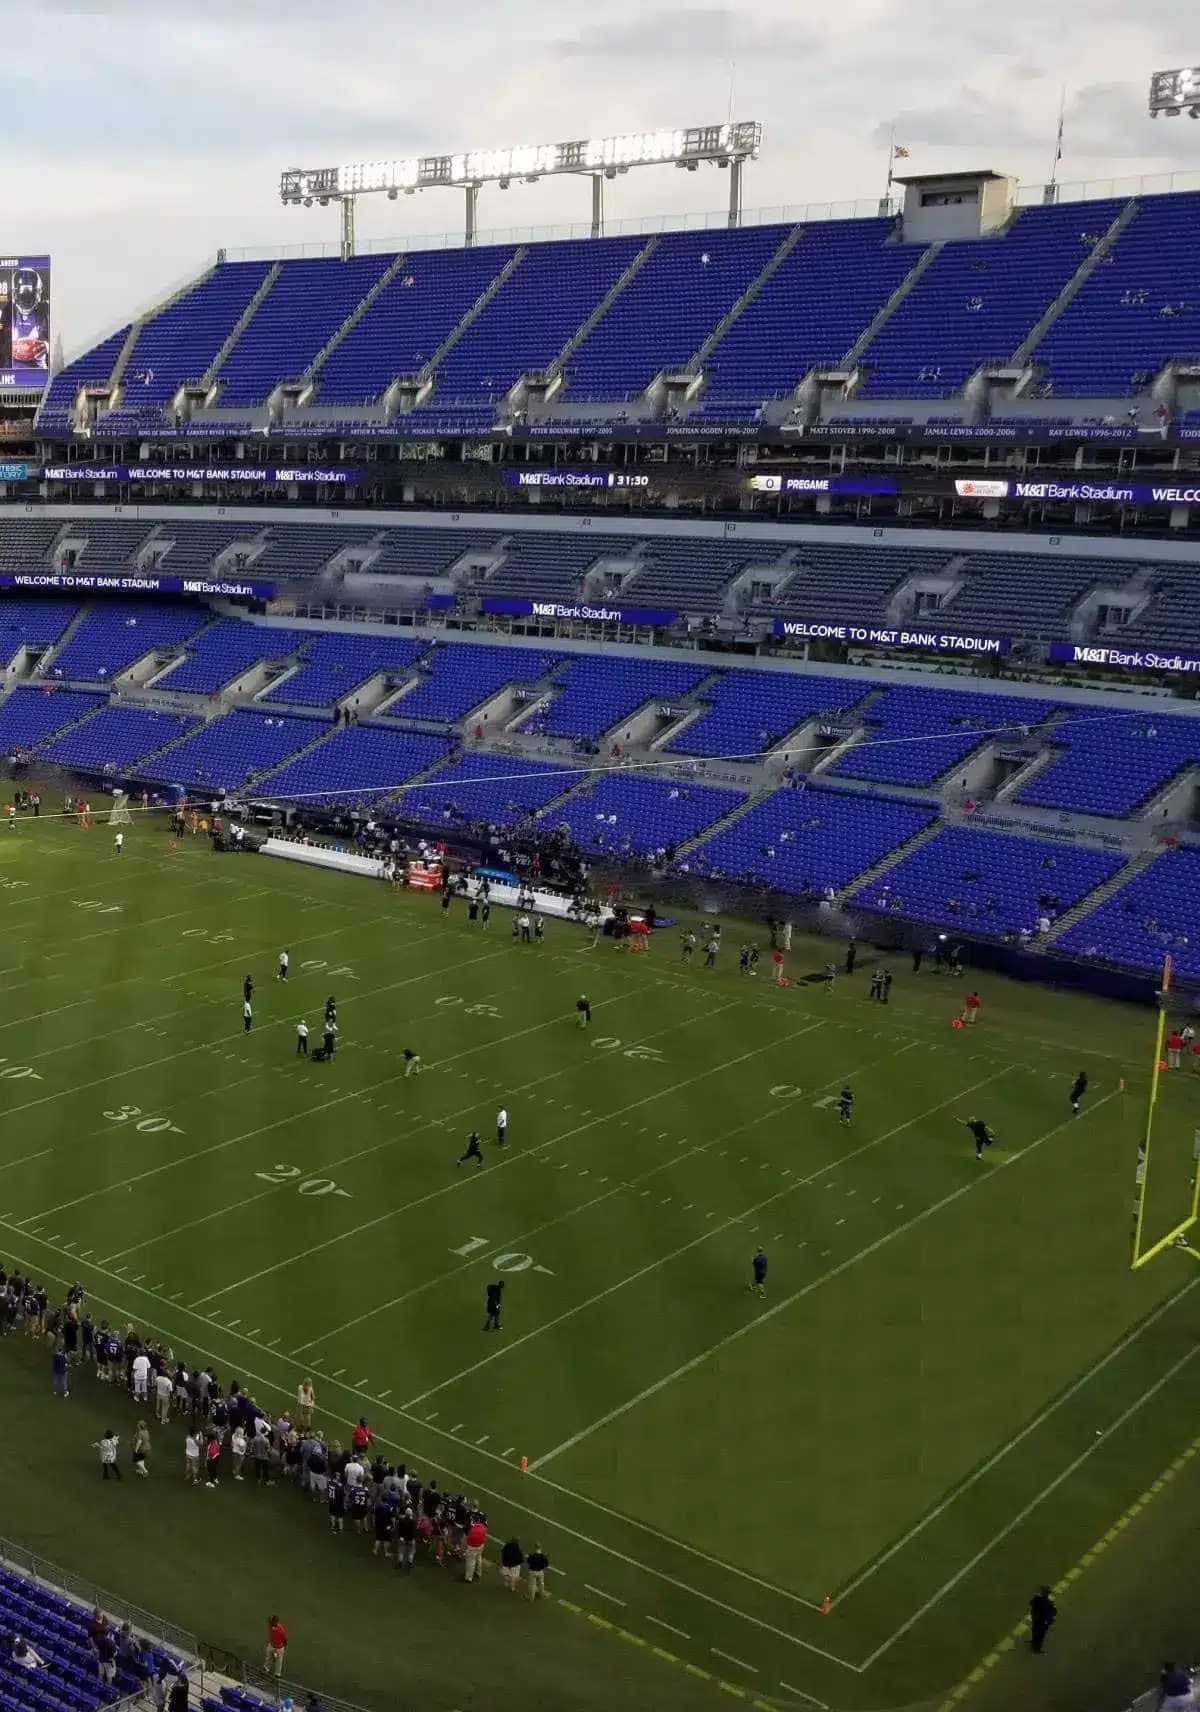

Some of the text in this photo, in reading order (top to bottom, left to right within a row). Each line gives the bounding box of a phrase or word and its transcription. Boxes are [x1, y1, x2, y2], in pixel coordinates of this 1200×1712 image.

[700, 427, 723, 435] OGDEN
[829, 427, 856, 435] STOVER
[923, 427, 948, 436] JAMAL
[949, 428, 973, 436] LEWIS
[1048, 428, 1063, 437] RAY
[1064, 429, 1088, 437] LEWIS
[84, 469, 117, 479] Stadium
[129, 469, 266, 480] WELCOME TO M&T BANK STADIUM
[314, 471, 346, 482] Stadium
[566, 473, 603, 486] Stadium
[787, 478, 829, 490] PREGAME
[1080, 485, 1133, 501] Stadium
[14, 575, 160, 589] WELCOME TO M&T BANK STADIUM
[220, 582, 253, 595] Stadium
[581, 606, 622, 620] Stadium
[783, 622, 1000, 652] WELCOME TO M&T BANK STADIUM
[1144, 652, 1200, 672] Stadium
[101, 1104, 174, 1134] 30
[254, 1164, 337, 1197] 20
[447, 1235, 534, 1273] 10
